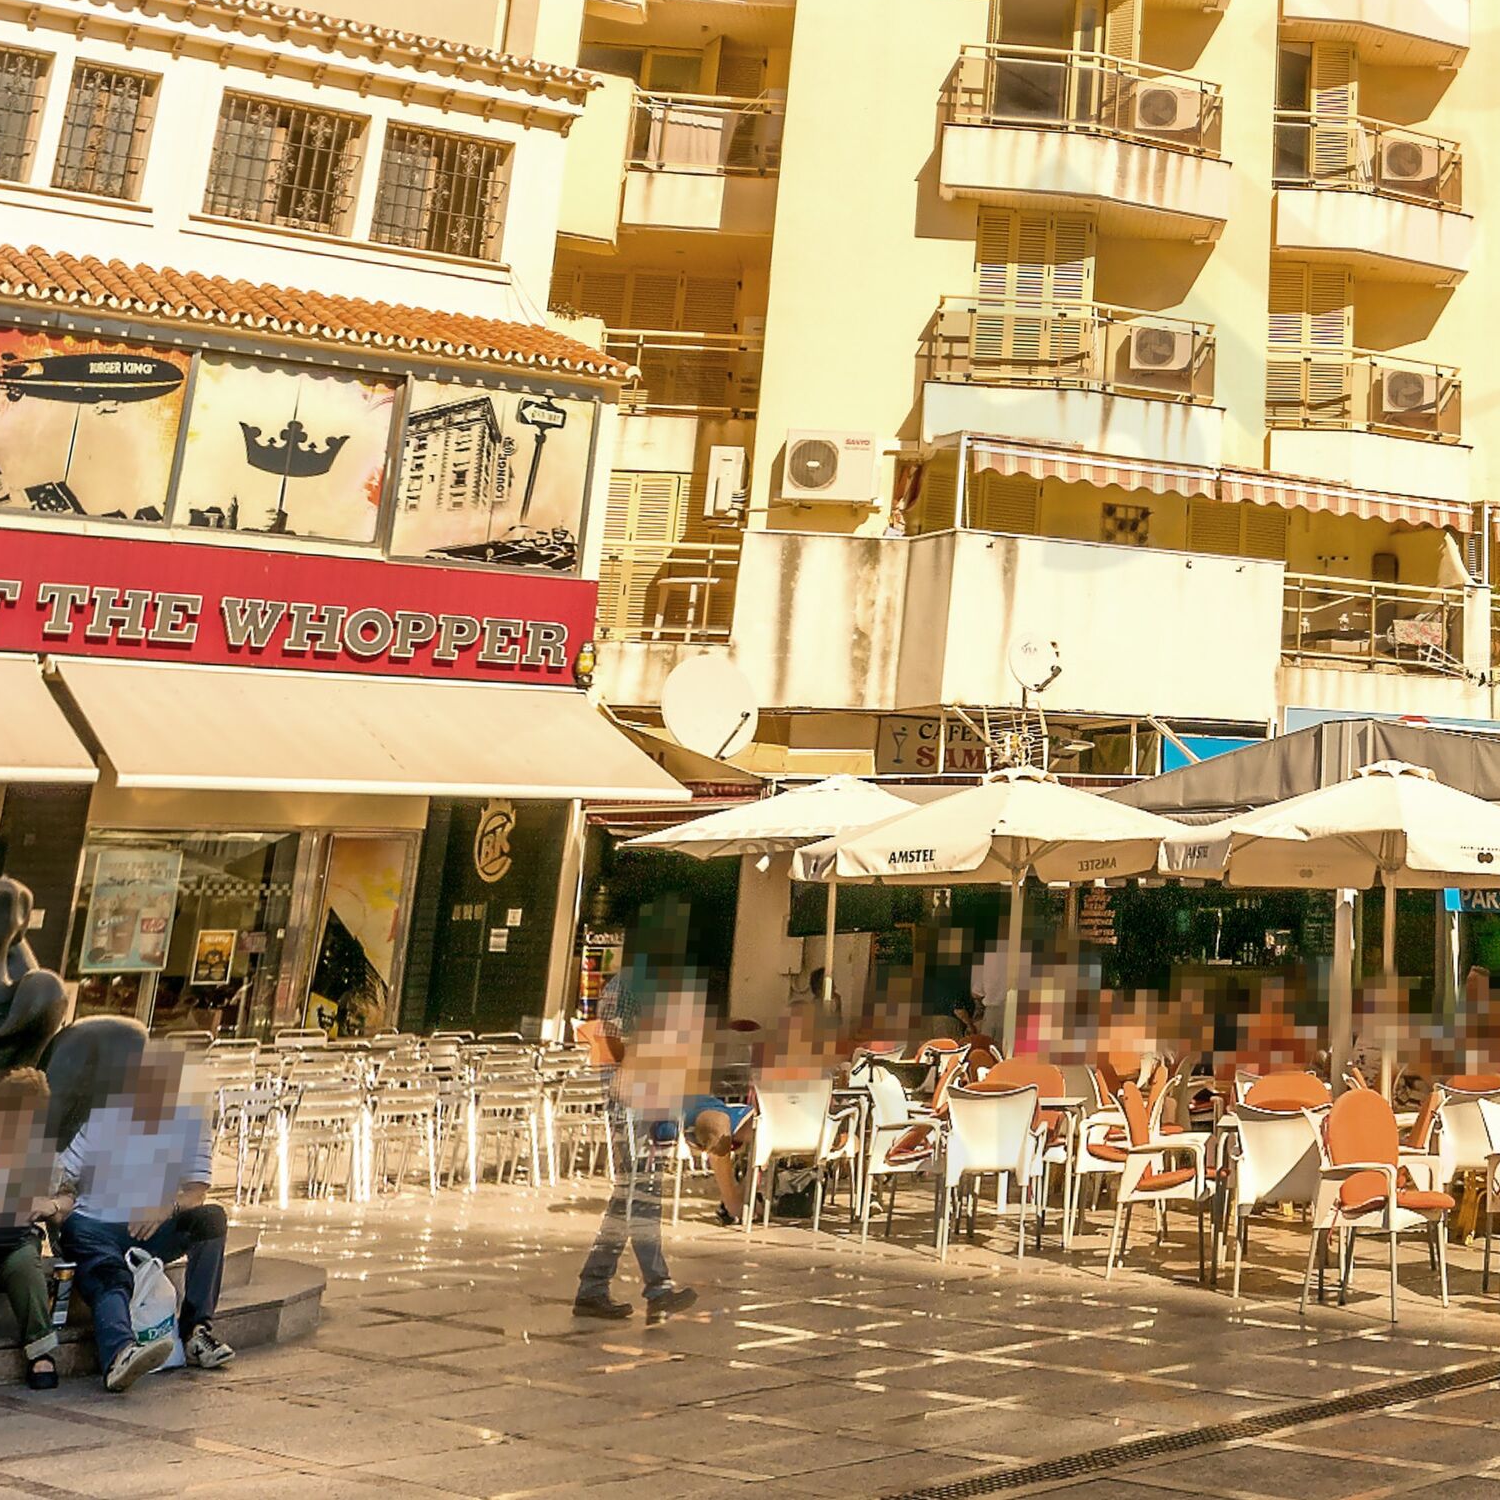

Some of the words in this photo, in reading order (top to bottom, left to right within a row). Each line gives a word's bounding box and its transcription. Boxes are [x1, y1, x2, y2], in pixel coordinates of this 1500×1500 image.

[89, 362, 122, 375] BURGER
[123, 362, 153, 374] KING
[495, 454, 508, 499] LOUNGE
[36, 581, 202, 643] THE
[220, 596, 569, 667] WHOPPER
[888, 848, 936, 865] AMSTEL
